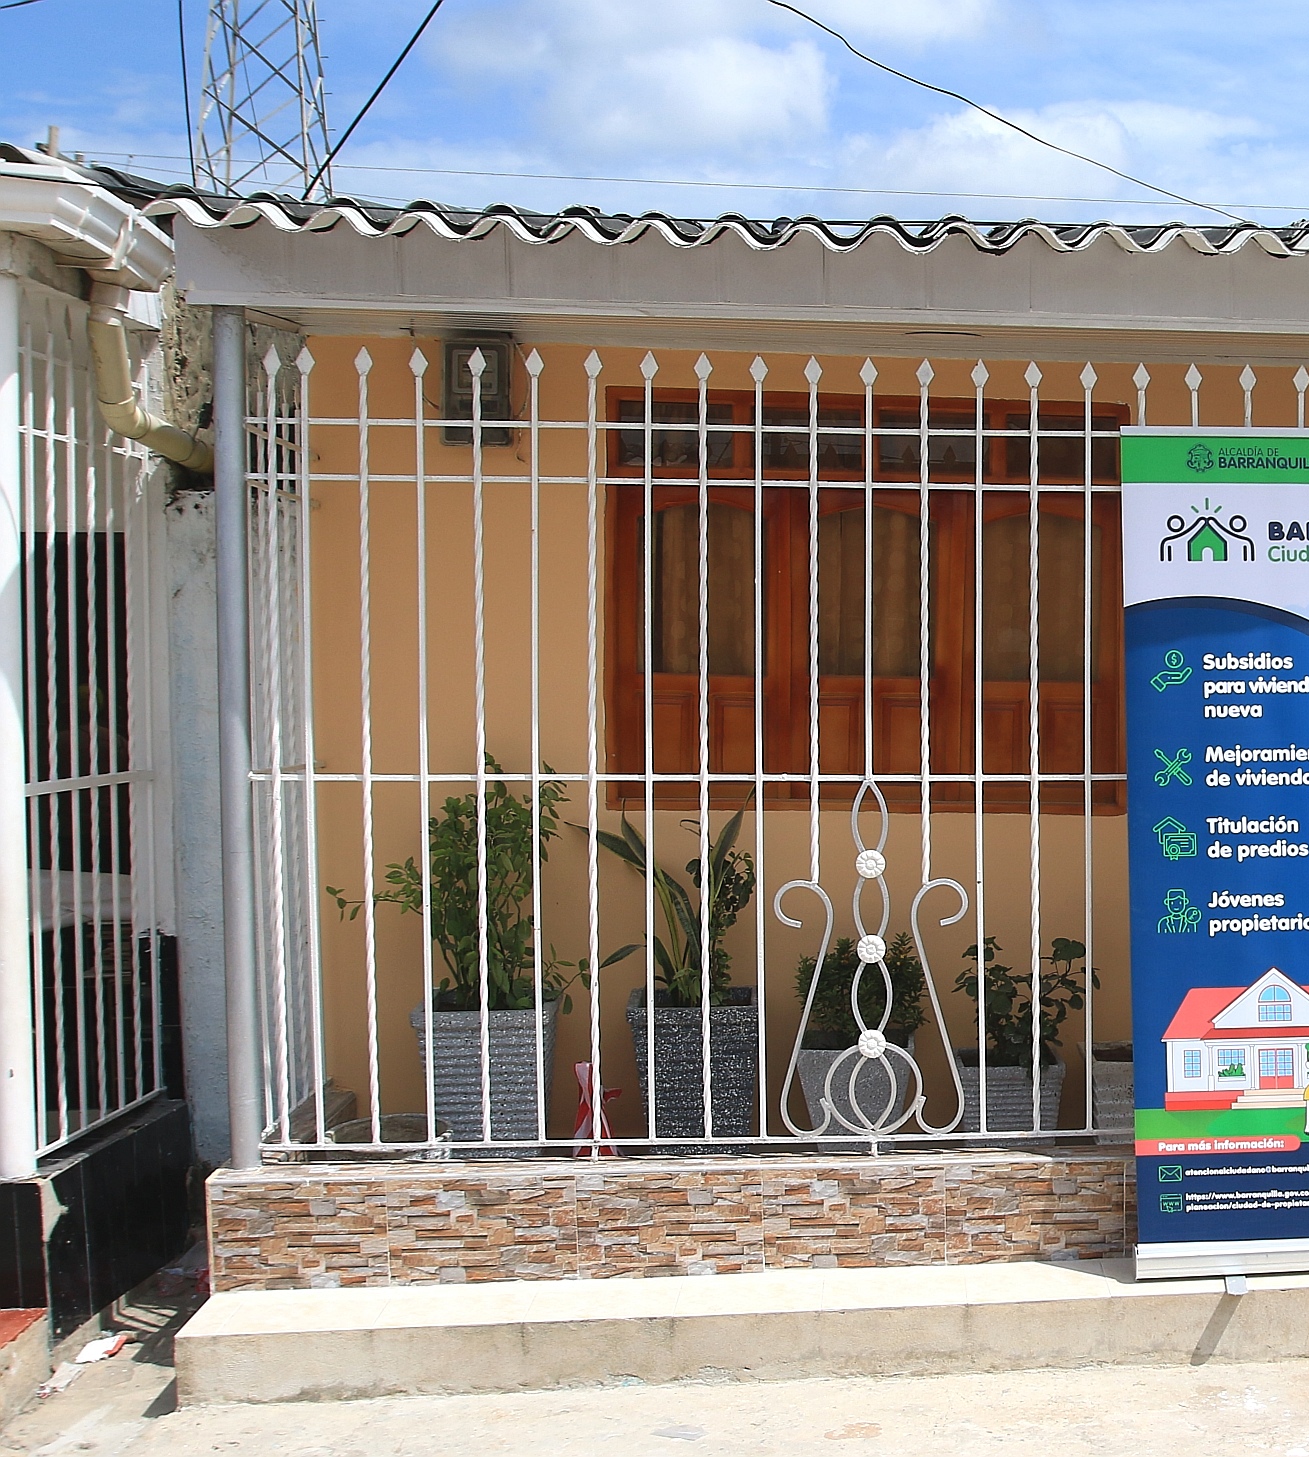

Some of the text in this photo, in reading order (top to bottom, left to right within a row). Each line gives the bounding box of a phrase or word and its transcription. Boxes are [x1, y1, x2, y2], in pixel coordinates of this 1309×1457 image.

[1218, 446, 1279, 457] ALCALDÍA DE
[1202, 652, 1294, 670] Subsidios
[1203, 680, 1246, 699] para
[1204, 704, 1263, 718] nueva
[1205, 769, 1231, 787] de
[1205, 815, 1299, 834] Titulación
[1207, 839, 1309, 862] de predios
[1207, 890, 1285, 908] Jóvenes
[1158, 1138, 1285, 1152] Para más información:
